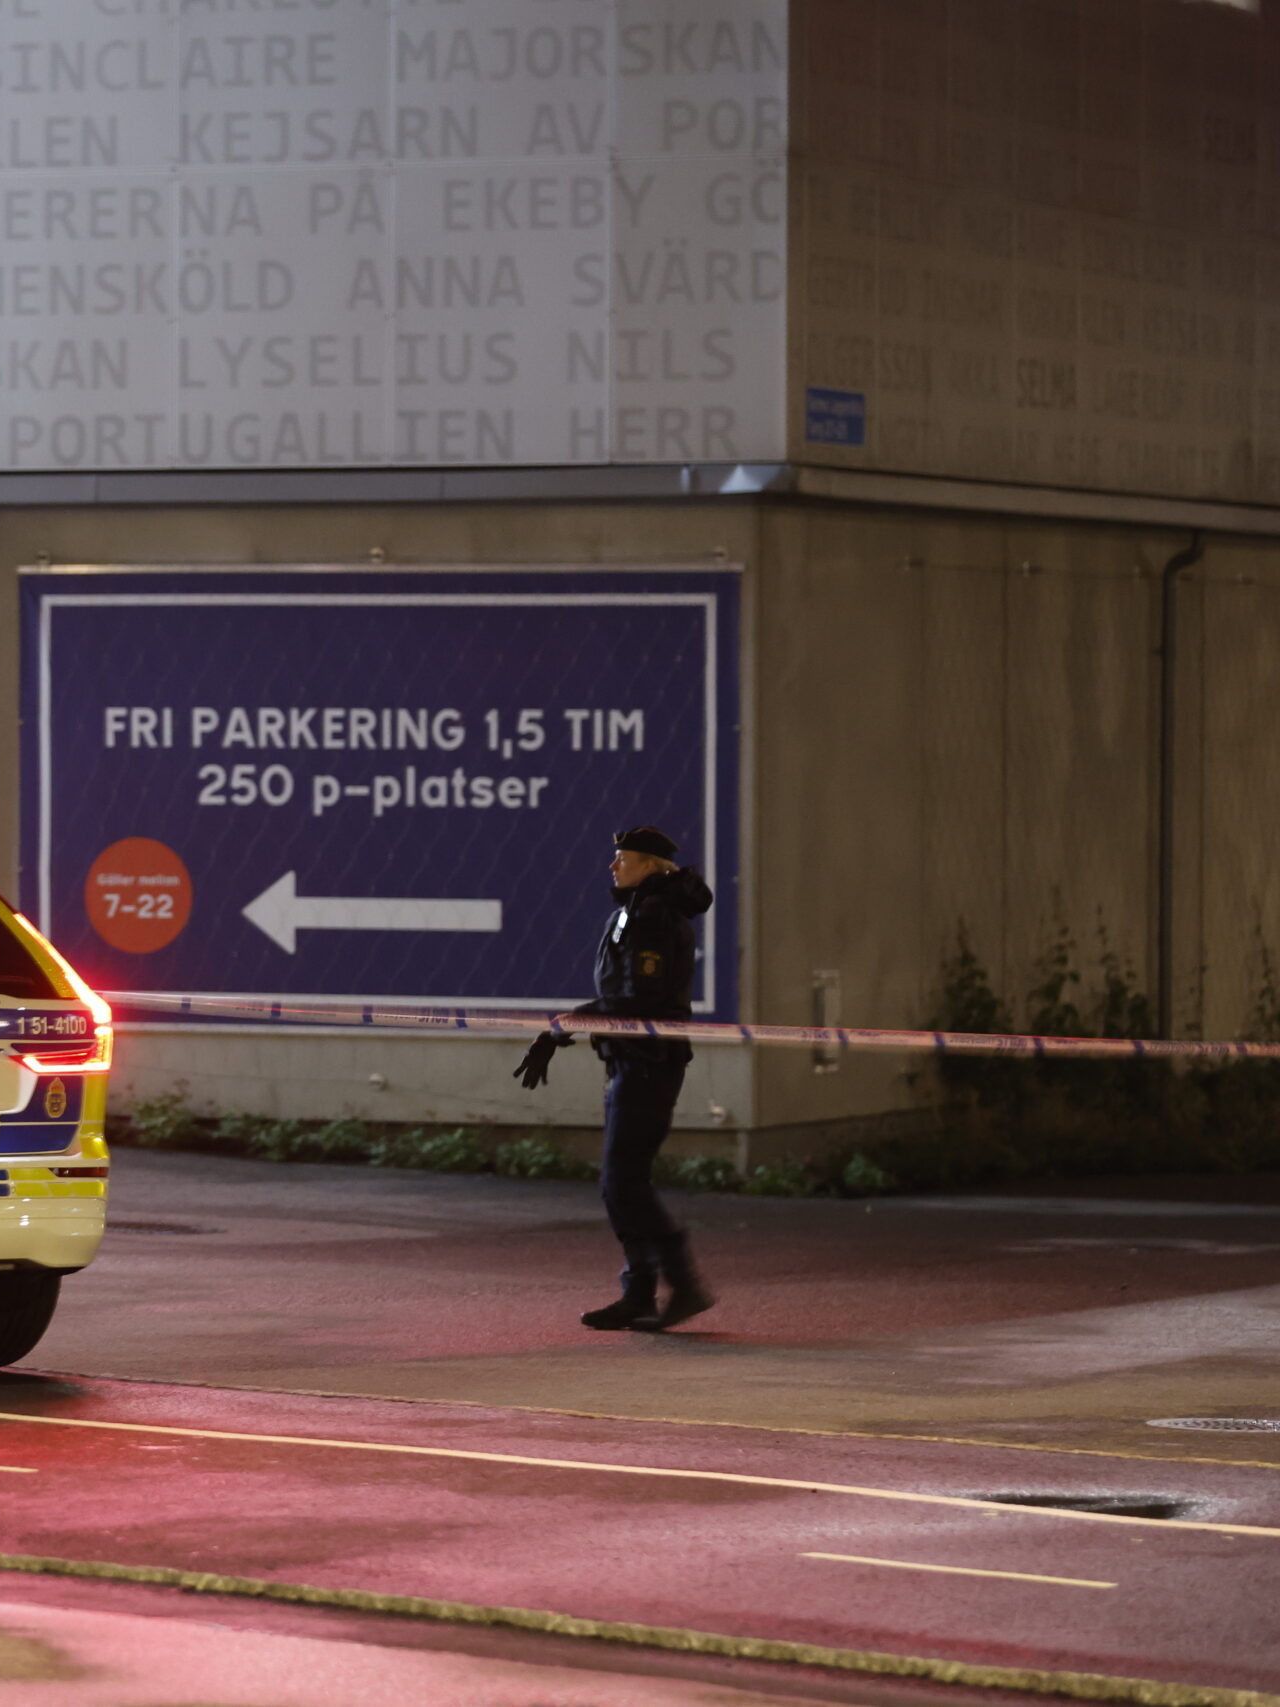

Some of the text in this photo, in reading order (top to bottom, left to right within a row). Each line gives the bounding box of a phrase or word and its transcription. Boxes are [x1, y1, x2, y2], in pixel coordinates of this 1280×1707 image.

[397, 19, 782, 83] MAJORSKAN
[180, 105, 478, 165] KEJSARN
[526, 103, 605, 156] AV
[309, 167, 385, 235] PÅ
[443, 174, 655, 232] EKEBY
[347, 256, 525, 311] ANNA
[572, 238, 782, 308] SVÄRD
[179, 332, 519, 388] LYSELIUS
[567, 328, 736, 383] NILS
[8, 409, 515, 468] PORTUGALLIEN
[569, 407, 739, 461] HERR
[104, 707, 645, 759] FRI PARKERING 1,5 TIM
[197, 764, 549, 817] 250 p-platser
[102, 893, 174, 918] 7-22
[17, 1016, 87, 1035] 1 51-4100
